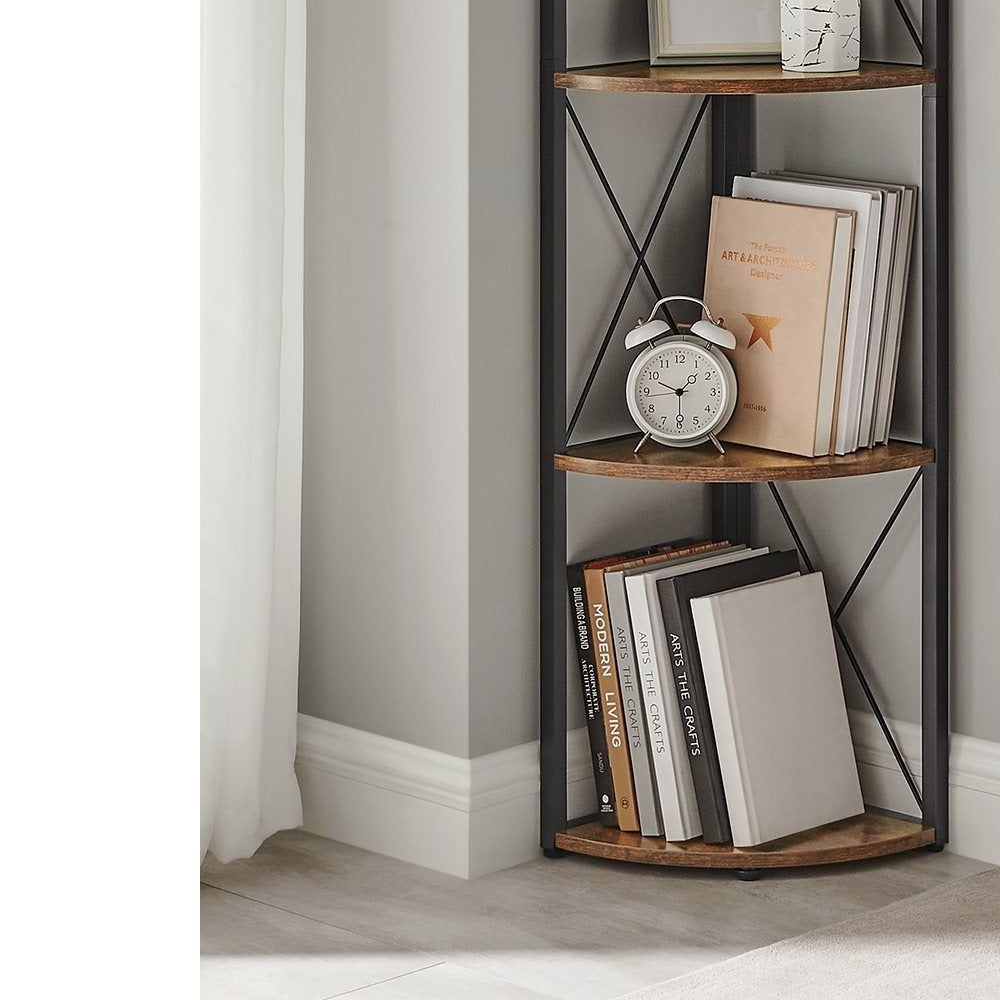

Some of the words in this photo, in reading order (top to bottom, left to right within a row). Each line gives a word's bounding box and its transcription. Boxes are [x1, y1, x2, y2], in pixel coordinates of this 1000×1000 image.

[660, 359, 669, 368] 11
[675, 354, 686, 364] 12
[649, 371, 659, 380] 10
[704, 371, 711, 381] 2
[643, 387, 650, 397] 9
[710, 387, 717, 396] 3
[648, 404, 655, 413] 8
[704, 405, 711, 413] 4
[660, 416, 667, 425] 7
[693, 416, 699, 425] 5
[616, 626, 629, 660] ARTS
[638, 631, 651, 665] ARTS
[670, 633, 685, 667] ARTS
[593, 604, 613, 677] MODERN
[605, 692, 621, 748] LIVING
[622, 666, 634, 692] THE
[645, 671, 657, 697] THE
[677, 672, 691, 700] THE
[627, 698, 642, 748] CRAFTS
[650, 703, 666, 754] CRAFTS
[683, 705, 701, 756] CRAFTS
